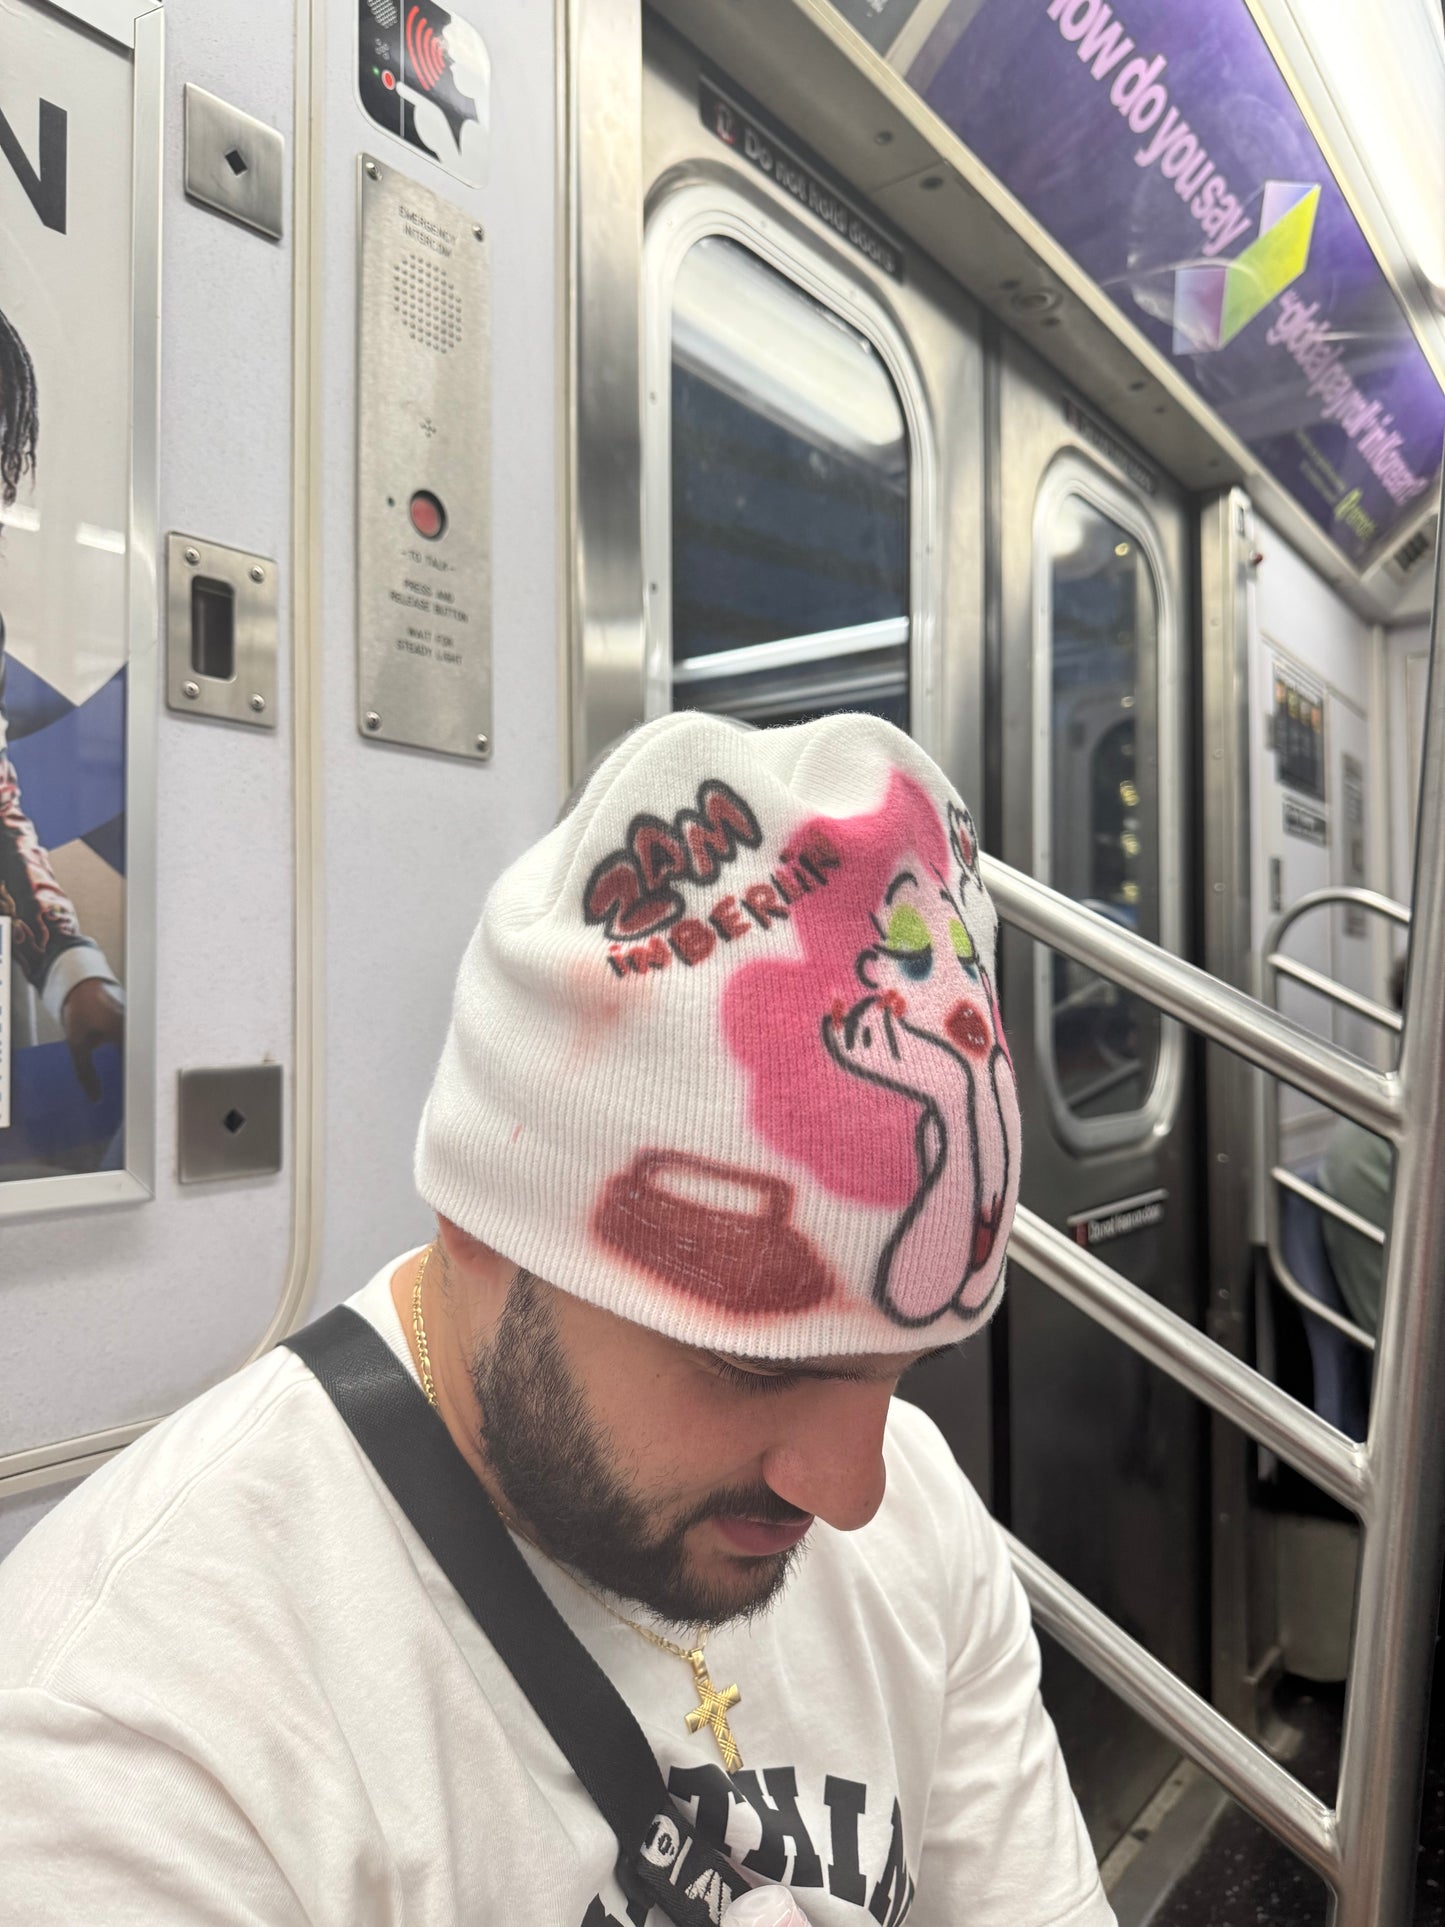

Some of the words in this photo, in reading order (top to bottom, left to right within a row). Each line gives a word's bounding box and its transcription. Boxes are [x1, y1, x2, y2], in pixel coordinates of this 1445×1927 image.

[1047, 0, 1135, 81] ow
[1110, 54, 1167, 133] do
[744, 129, 773, 171] Do
[1134, 105, 1215, 202] you
[399, 205, 456, 246] EMERGENCY
[1191, 175, 1251, 256] say
